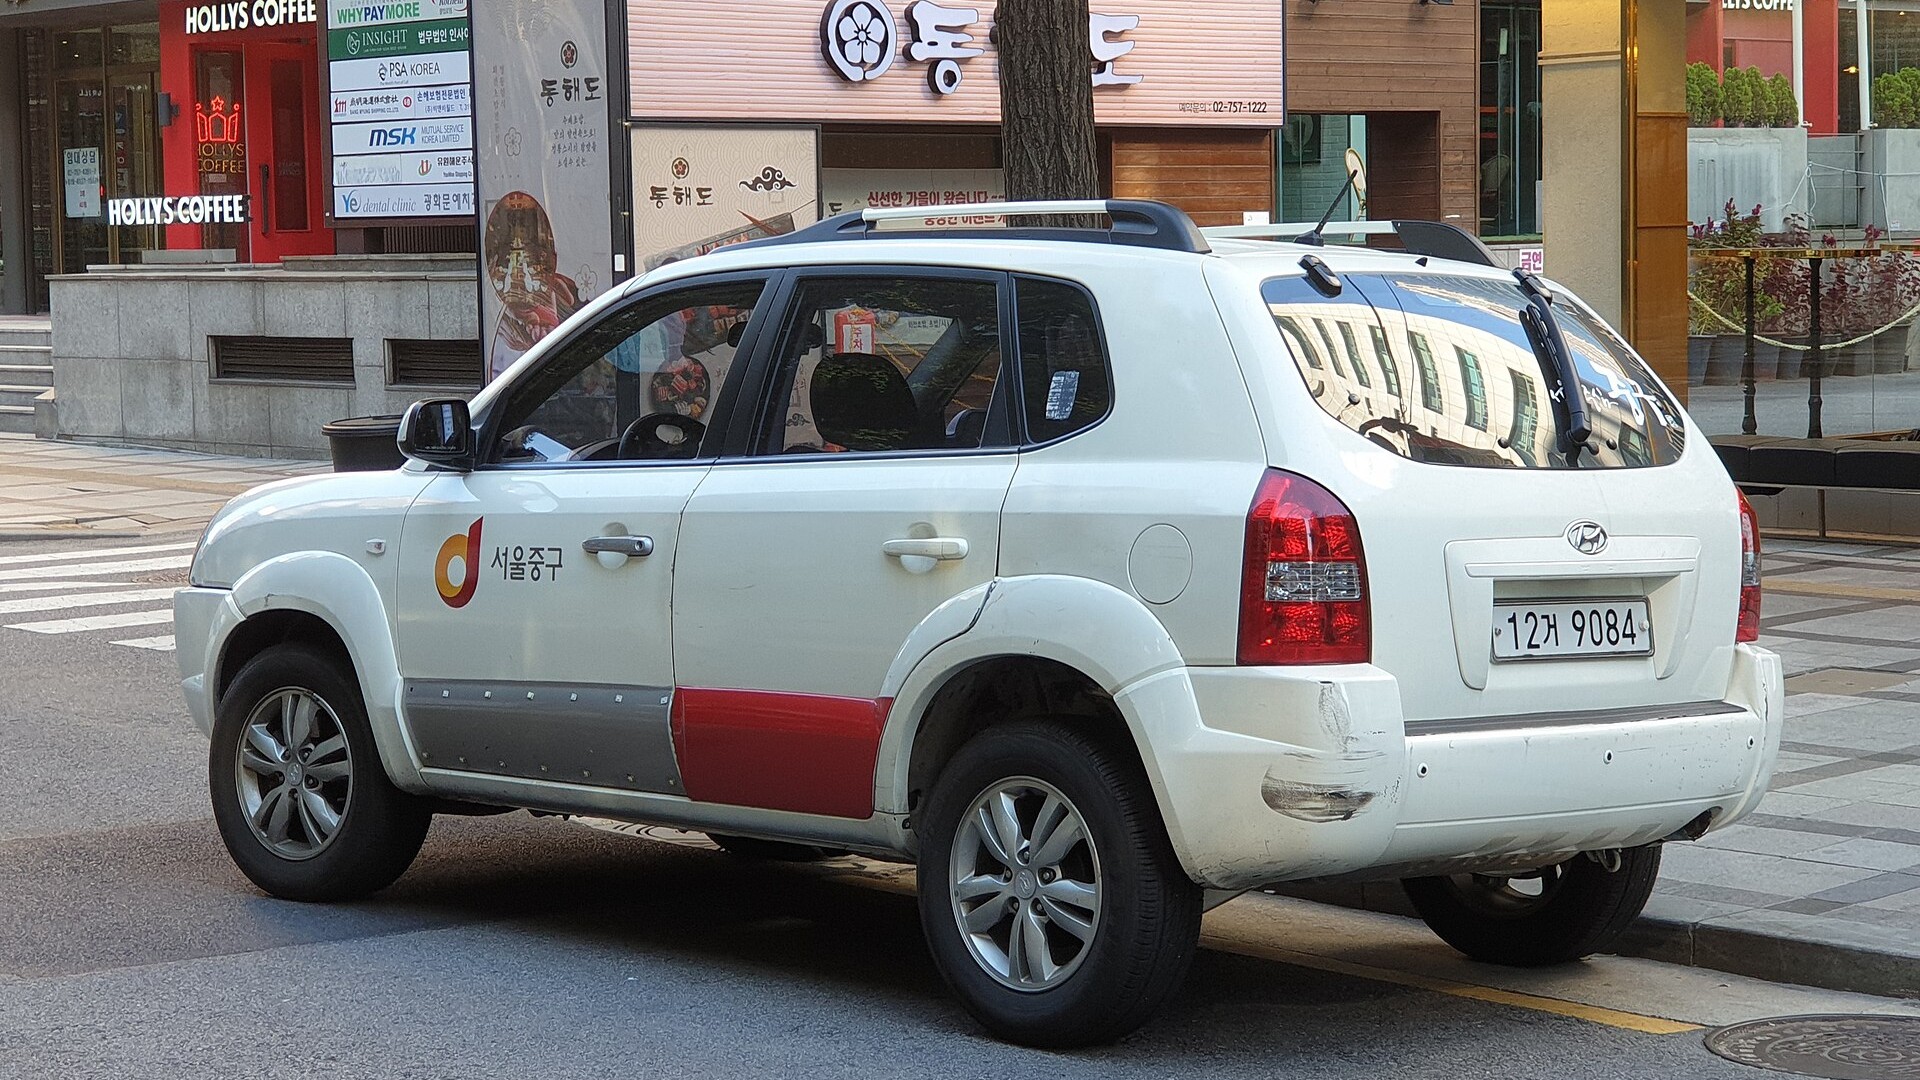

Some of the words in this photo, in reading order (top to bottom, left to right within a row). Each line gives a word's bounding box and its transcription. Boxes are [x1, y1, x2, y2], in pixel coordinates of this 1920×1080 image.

[186, 1, 248, 34] HOLLYS
[252, 0, 317, 26] COFFEE
[337, 2, 420, 24] WHYPAYMORE
[362, 29, 408, 46] INSIGHT
[418, 29, 447, 44] 법무법인
[903, 0, 1144, 95] 동도
[389, 62, 408, 77] PSA
[410, 62, 441, 76] KOREA
[540, 77, 601, 107] 동해도
[1179, 102, 1207, 113] 예약문의
[1213, 101, 1268, 113] 02-757-1222
[421, 126, 442, 135] MUTUAL
[443, 124, 464, 134] SERVICE
[421, 135, 438, 144] KOREA
[439, 134, 460, 143] LIMITED
[66, 151, 96, 165] 임대상담
[363, 198, 389, 213] dental
[392, 197, 416, 212] clinic
[649, 185, 714, 210] 동해도
[867, 190, 903, 208] 신선한
[906, 190, 941, 207] 가을이
[943, 190, 989, 206] 왔습니다
[108, 198, 174, 226] HOLLYS
[177, 195, 245, 224] COFFEE
[1521, 251, 1542, 271] 금연
[853, 326, 863, 351] 주차
[491, 546, 563, 581] 서울중구
[1507, 611, 1559, 650] 12거
[1571, 608, 1637, 647] 9084
